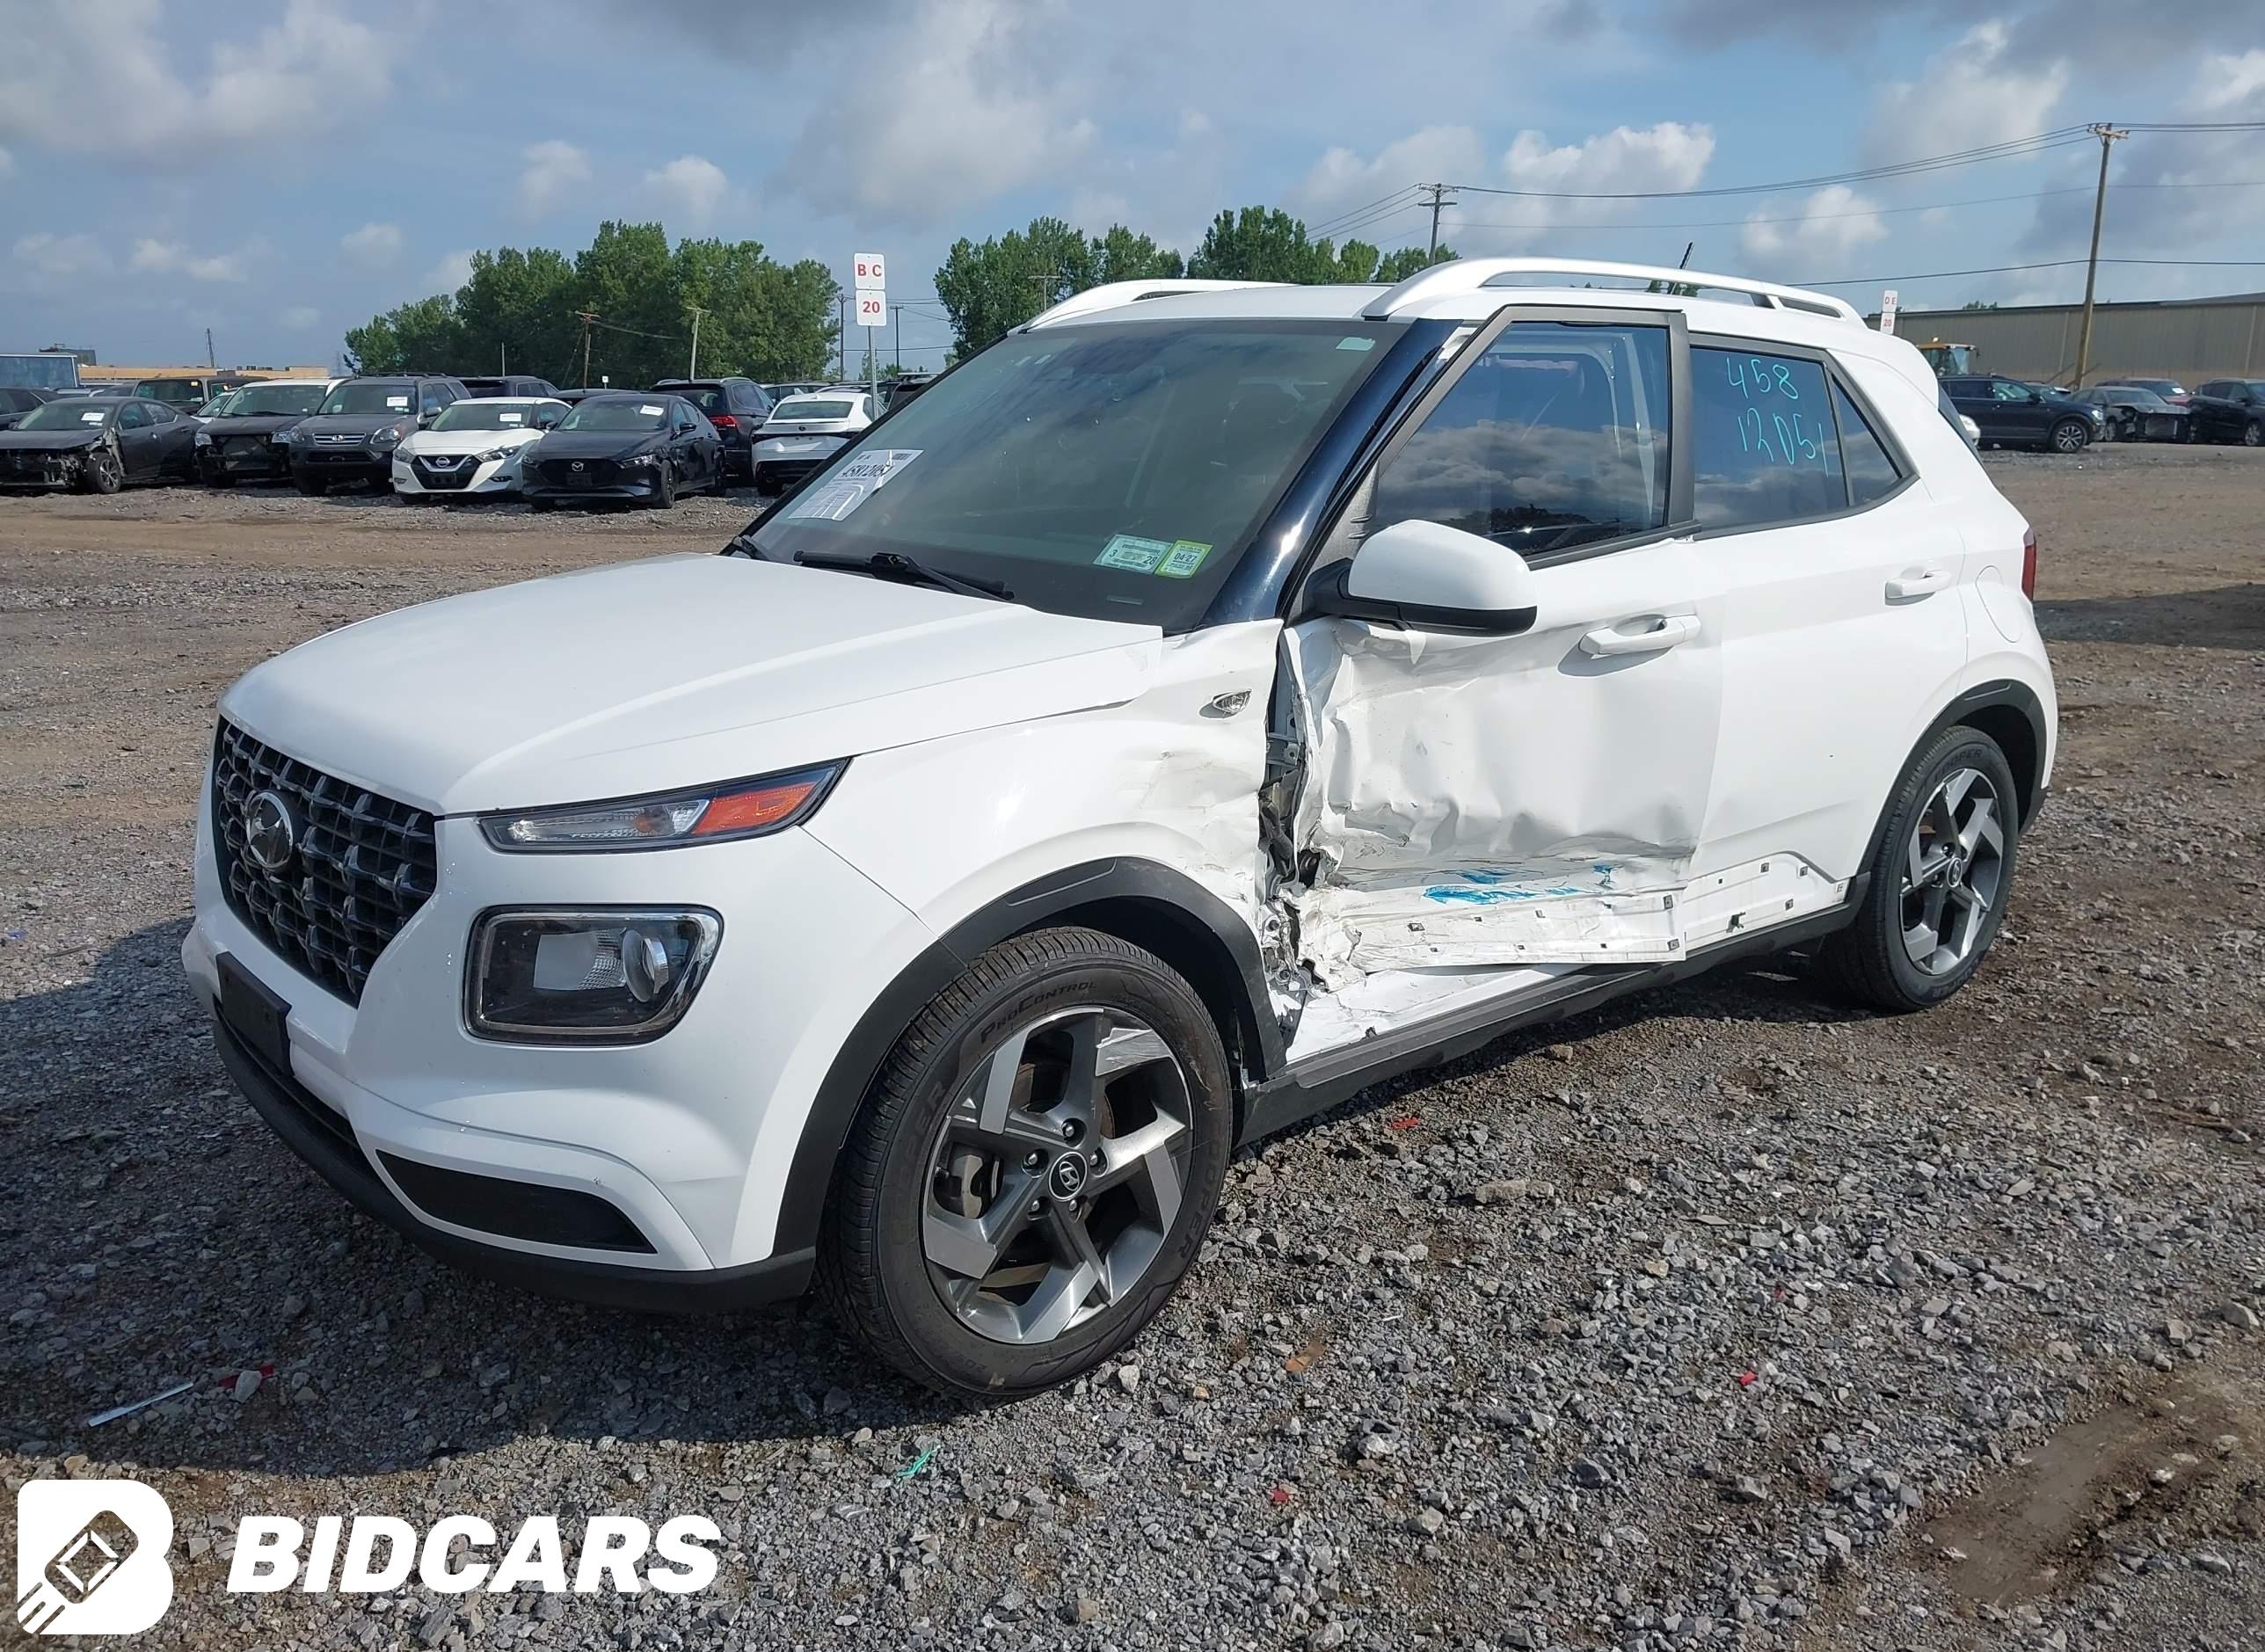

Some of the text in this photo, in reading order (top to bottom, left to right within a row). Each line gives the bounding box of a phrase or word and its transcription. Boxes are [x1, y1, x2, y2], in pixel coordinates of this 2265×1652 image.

[857, 264, 883, 277] B C
[863, 301, 880, 314] 20
[1883, 318, 1892, 327] 20
[1726, 357, 1799, 400] 458
